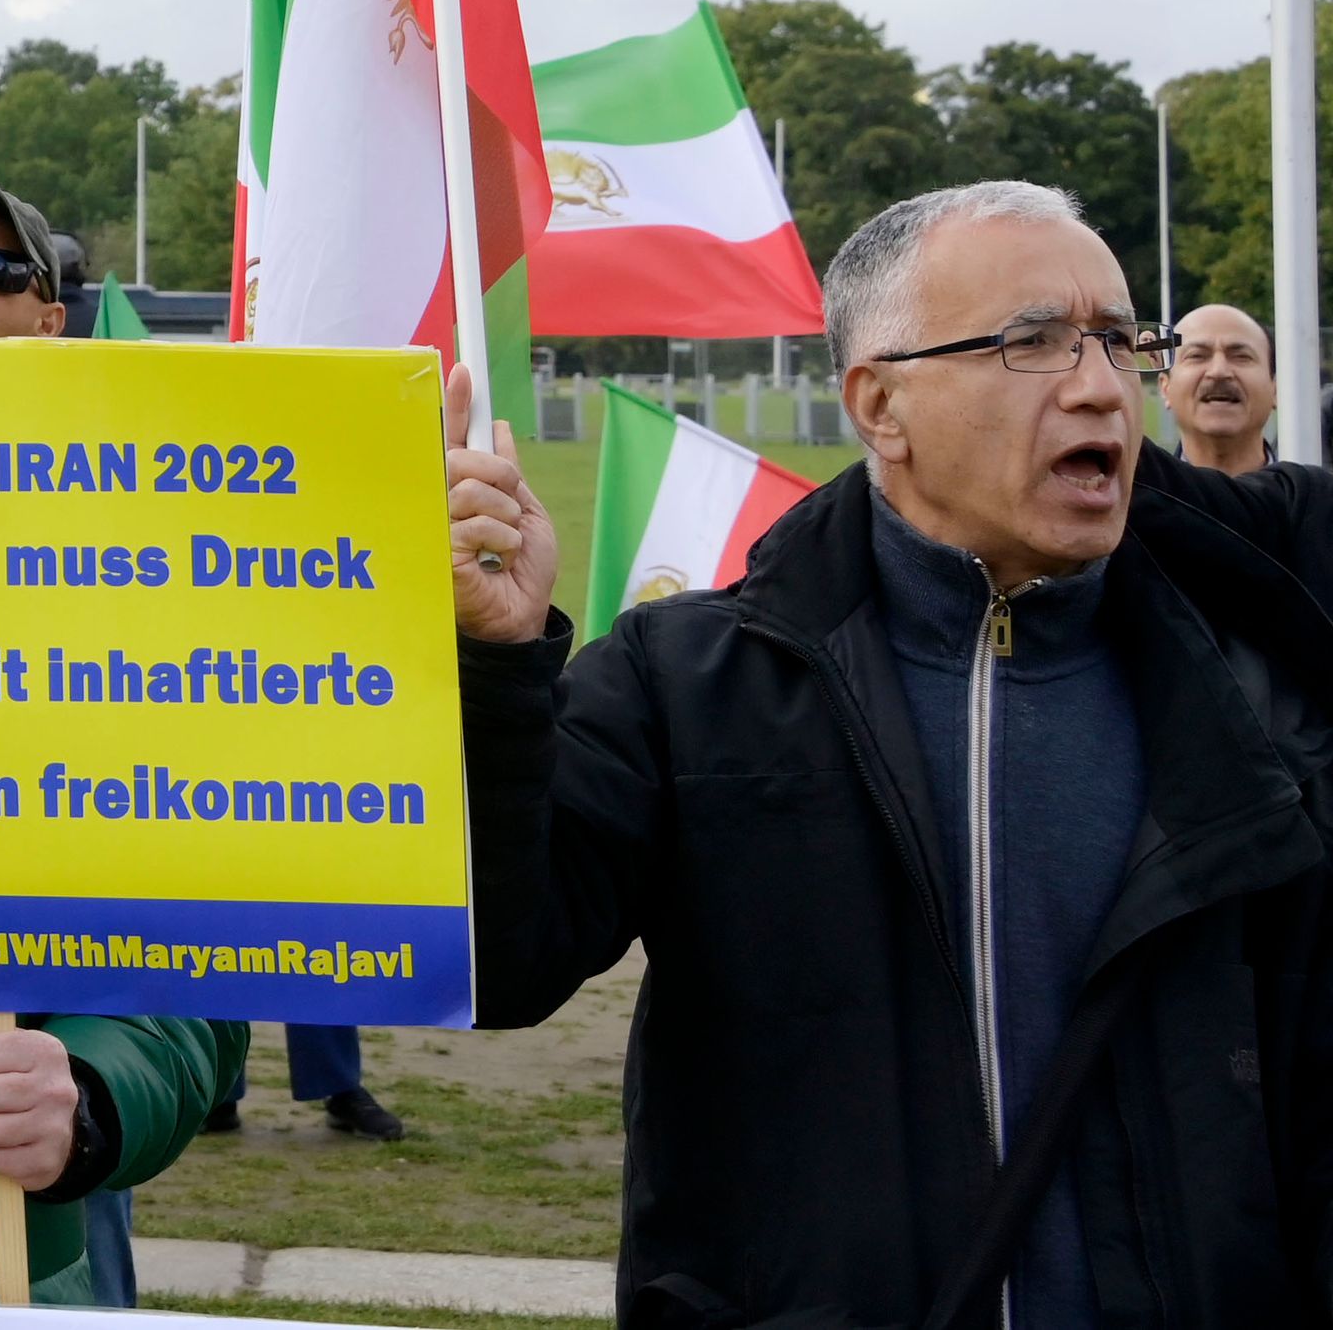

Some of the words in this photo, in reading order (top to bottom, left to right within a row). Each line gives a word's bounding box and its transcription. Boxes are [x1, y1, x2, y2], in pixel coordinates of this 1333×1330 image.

[153, 444, 297, 494] 2022
[6, 545, 170, 588] muss
[191, 534, 375, 589] Druck
[48, 647, 394, 706] inhaftierte
[38, 763, 425, 825] freikommen
